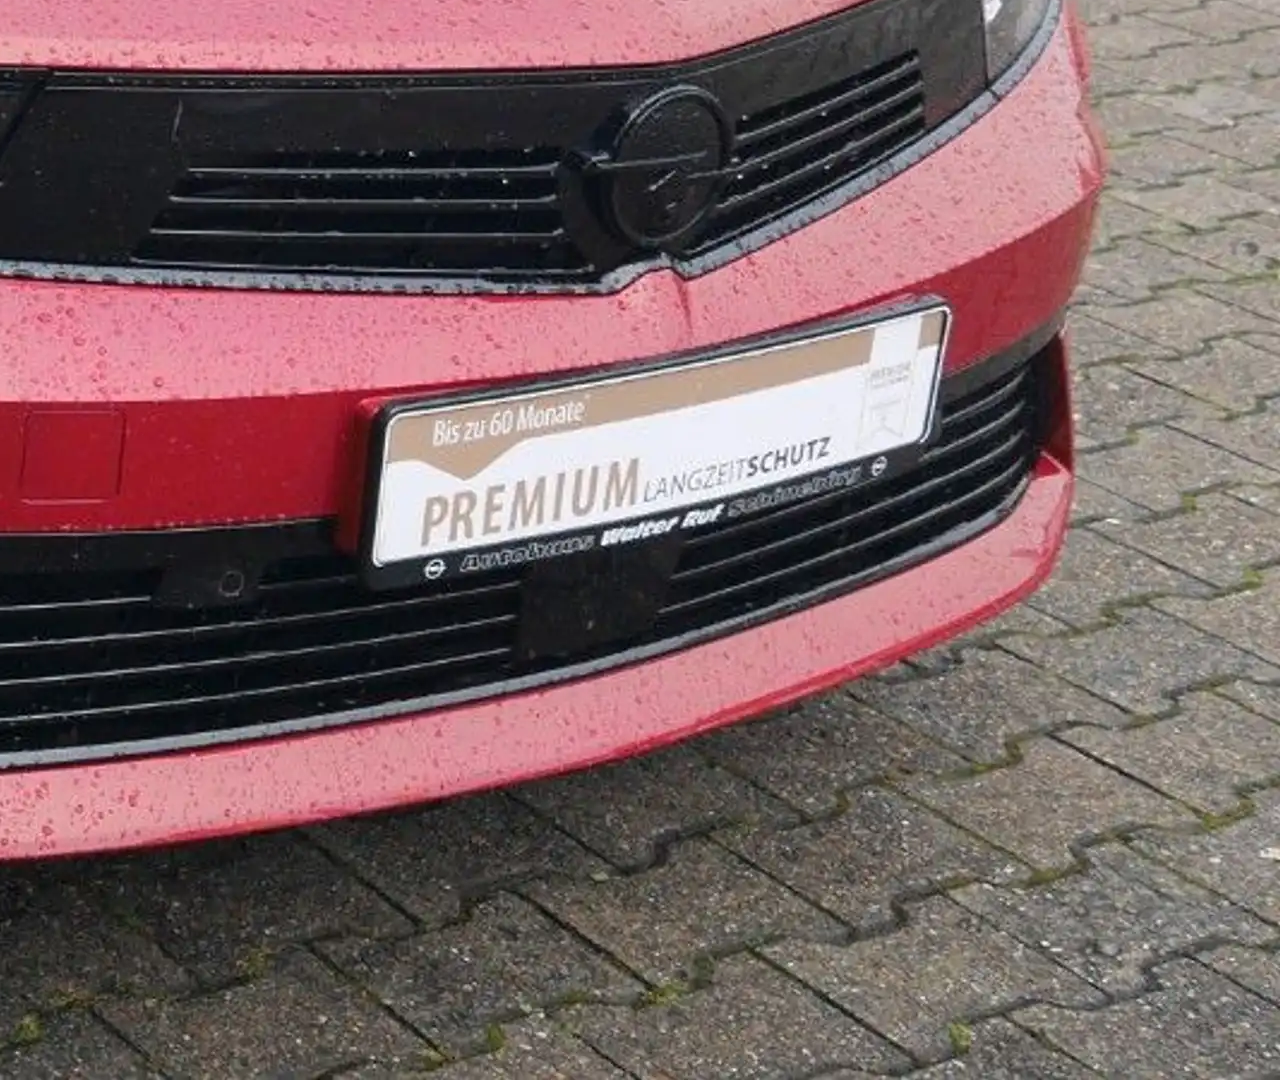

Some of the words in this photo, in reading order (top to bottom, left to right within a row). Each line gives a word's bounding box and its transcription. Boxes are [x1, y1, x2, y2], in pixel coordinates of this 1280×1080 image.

[432, 419, 460, 446] Bis
[464, 421, 485, 441] zu
[489, 408, 513, 436] 60
[517, 400, 586, 431] Monate
[420, 457, 640, 547] PREMIUM
[643, 436, 831, 503] LANGZEITSCHUTZ
[459, 535, 596, 573] Autohaus
[600, 516, 680, 547] Walter
[680, 504, 725, 530] Ruf
